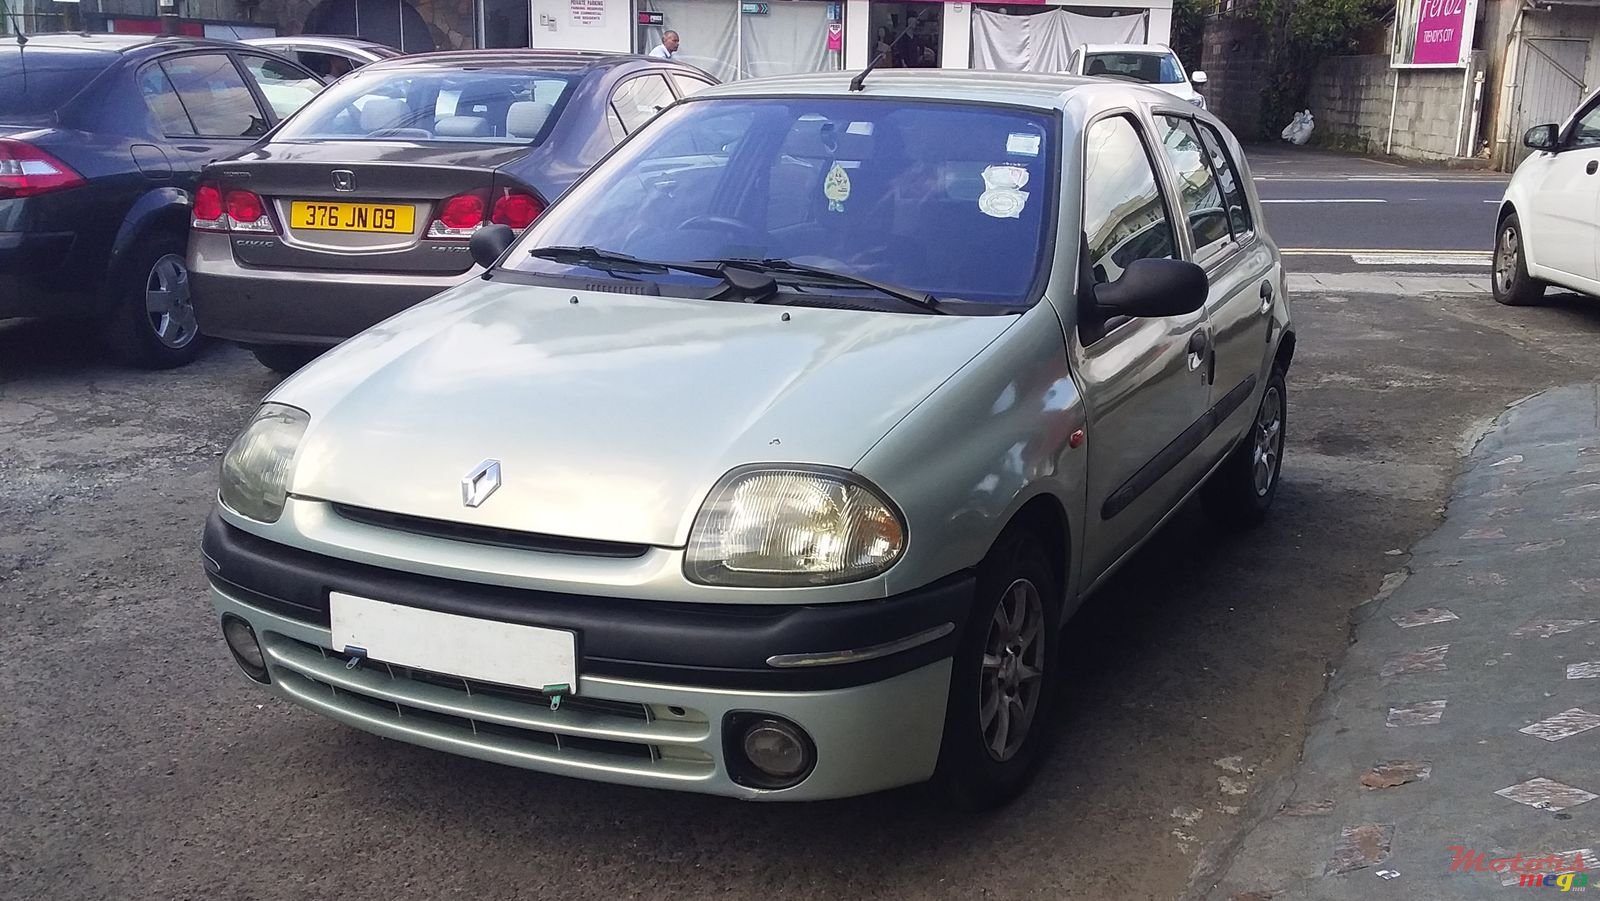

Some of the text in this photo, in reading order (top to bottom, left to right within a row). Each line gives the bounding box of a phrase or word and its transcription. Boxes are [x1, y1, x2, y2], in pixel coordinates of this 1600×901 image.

[1444, 29, 1454, 42] CITY
[305, 205, 395, 229] 376 JN 09
[236, 239, 275, 248] CIVIC
